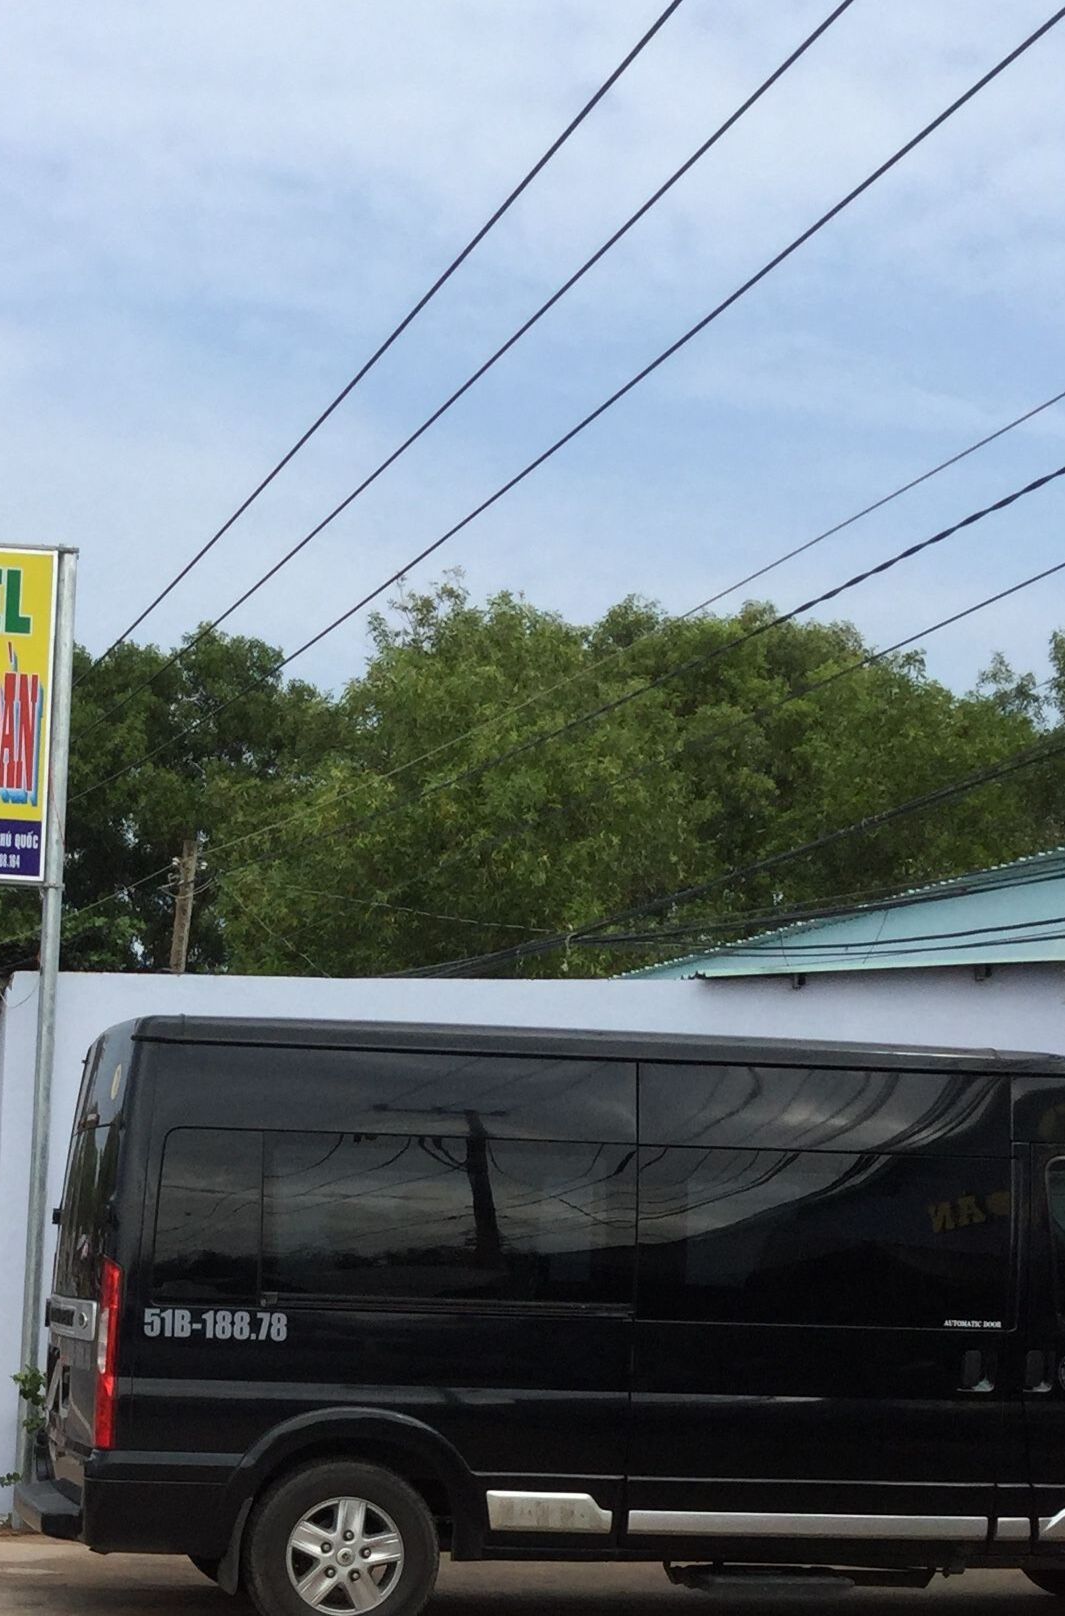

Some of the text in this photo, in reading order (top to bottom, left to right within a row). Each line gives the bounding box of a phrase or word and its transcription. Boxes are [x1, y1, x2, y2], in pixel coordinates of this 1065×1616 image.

[14, 830, 39, 850] QUỐC
[143, 1308, 287, 1341] 51B-188.78
[943, 1319, 1002, 1329] AUTOMATIC DOOR
